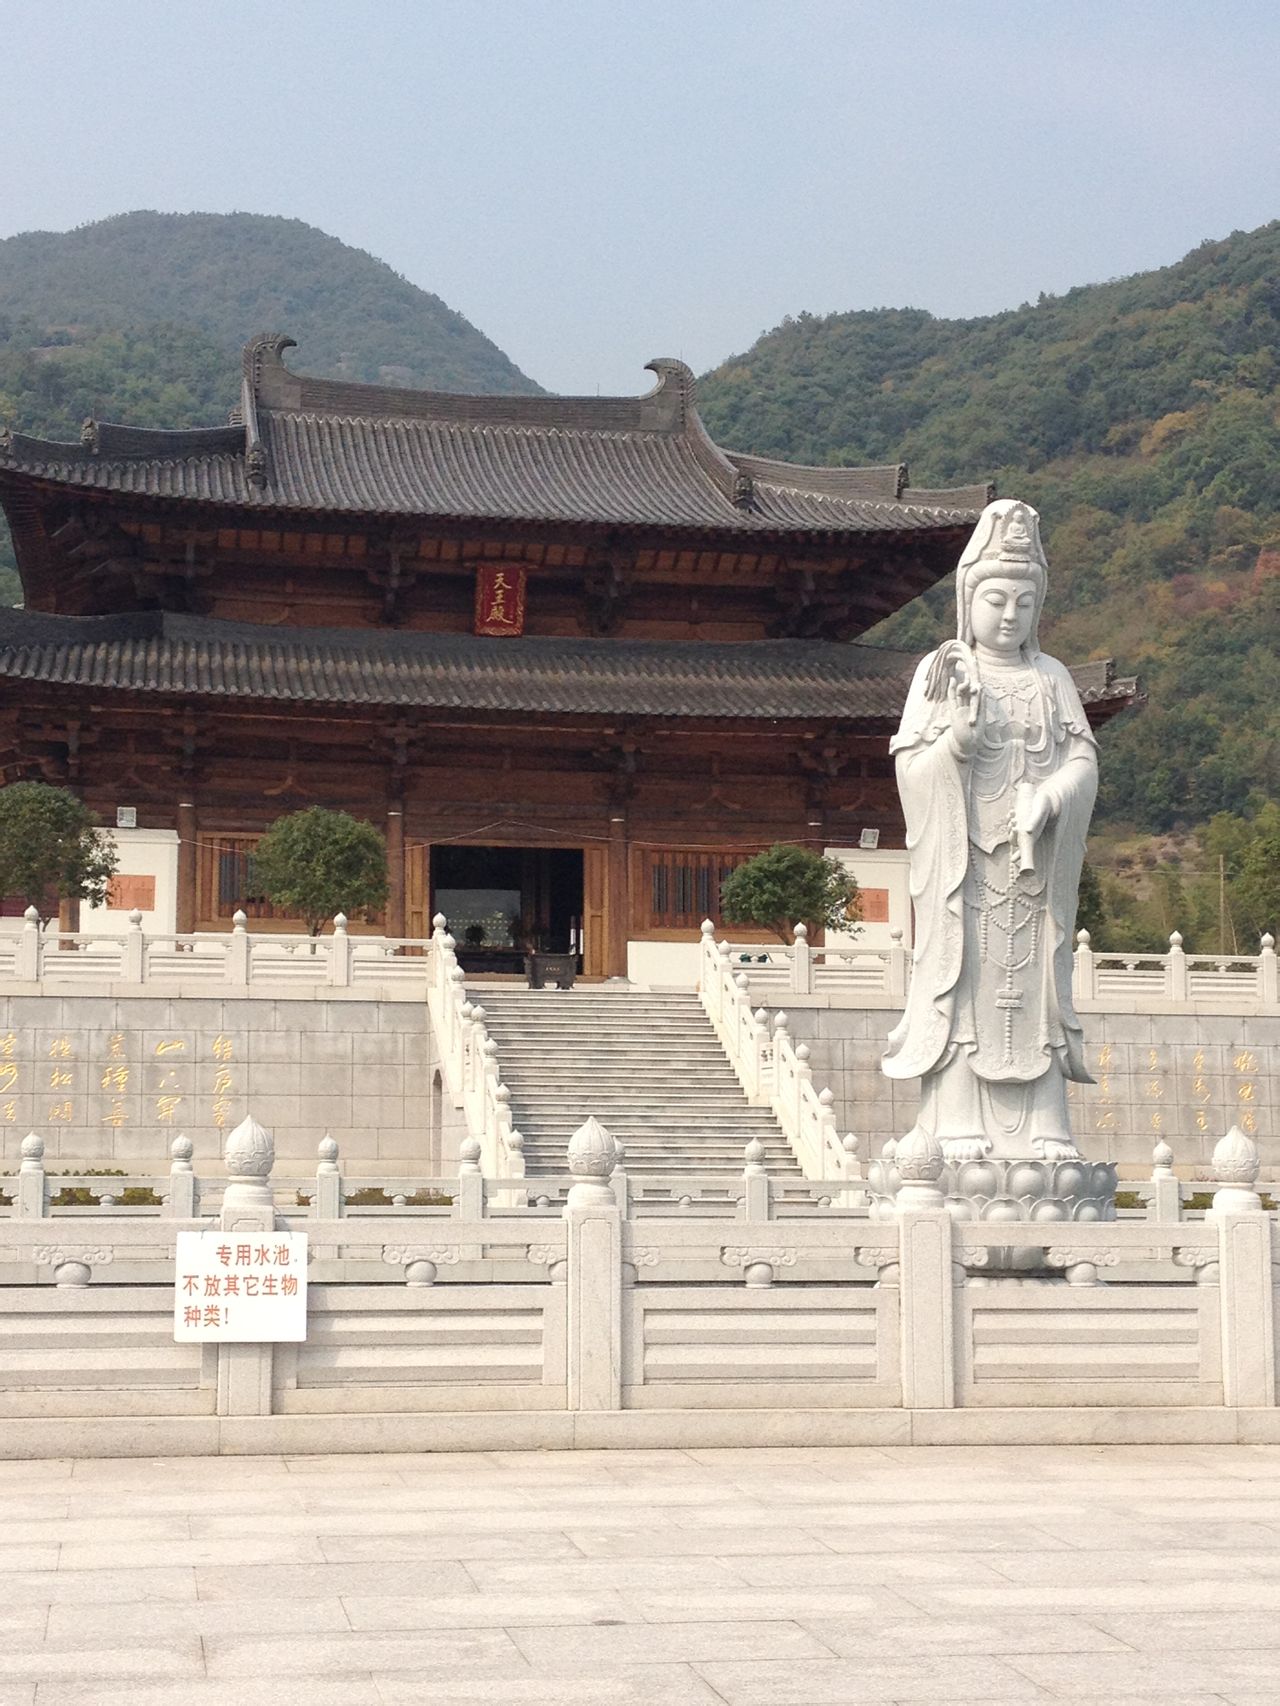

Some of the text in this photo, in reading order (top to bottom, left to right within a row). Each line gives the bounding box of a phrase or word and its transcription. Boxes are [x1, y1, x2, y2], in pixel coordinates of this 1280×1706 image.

[182, 1274, 298, 1297] 不放其它生物
[183, 1304, 229, 1327] 种类!
